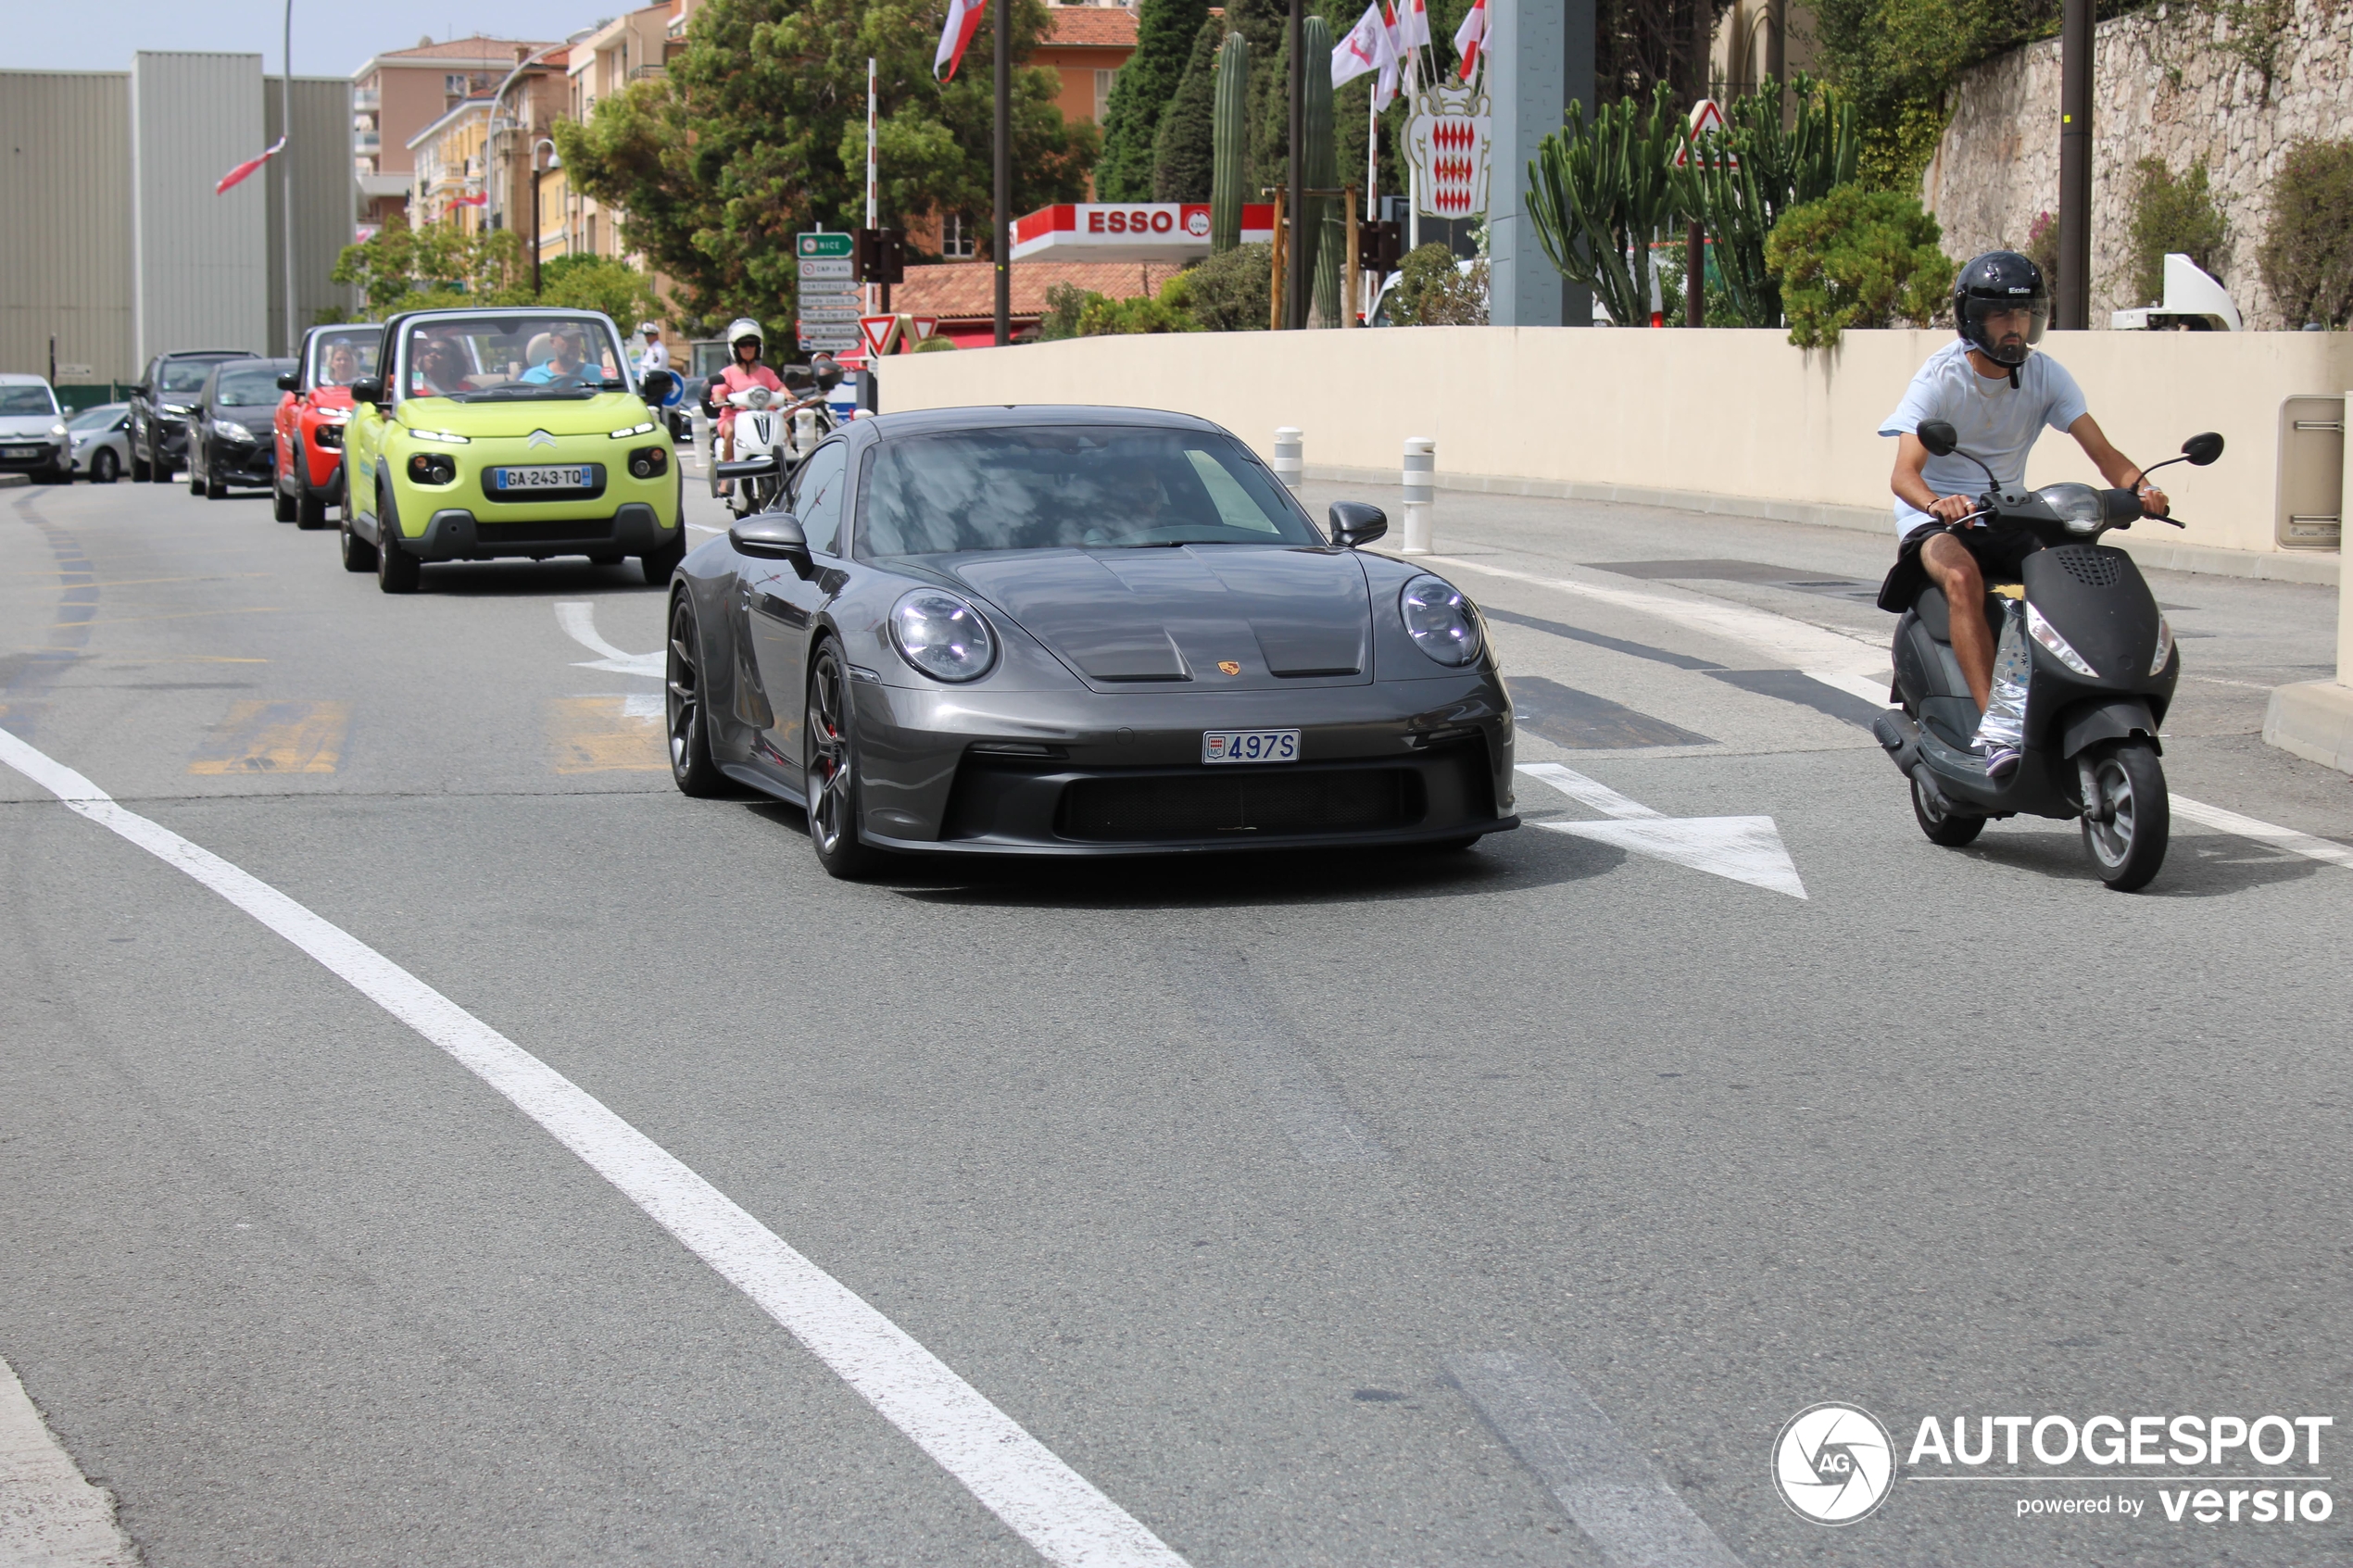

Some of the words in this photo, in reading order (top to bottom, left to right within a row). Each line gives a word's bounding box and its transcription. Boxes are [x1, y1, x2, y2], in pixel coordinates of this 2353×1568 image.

[1088, 210, 1173, 233] ESSO
[819, 241, 840, 249] NICE
[507, 470, 582, 486] GA-243-TQ
[1210, 747, 1222, 756] MC
[1228, 734, 1294, 759] 497S
